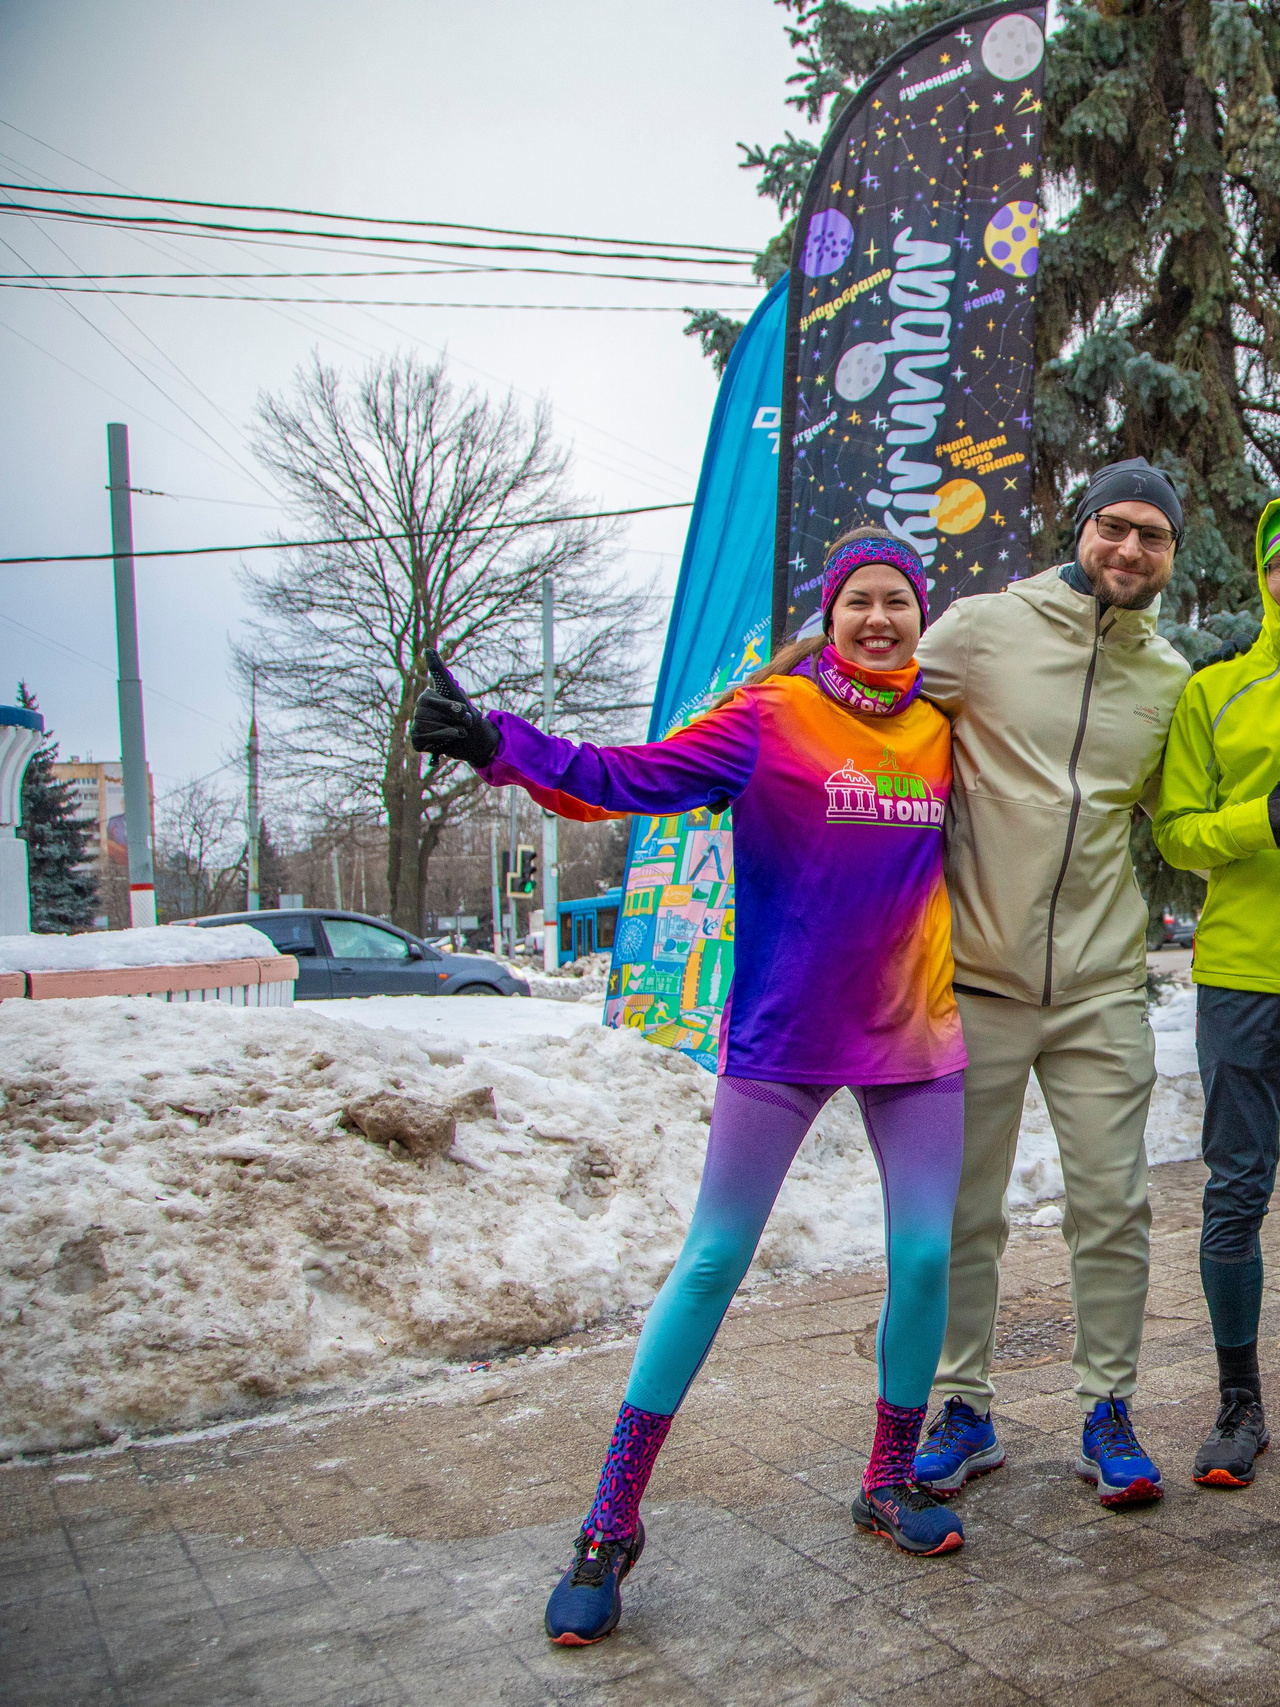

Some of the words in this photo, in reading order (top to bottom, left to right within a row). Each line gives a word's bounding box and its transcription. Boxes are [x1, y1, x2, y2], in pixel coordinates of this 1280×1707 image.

[800, 268, 892, 332] #надобрать
[935, 435, 973, 457] #чат
[950, 434, 1007, 467] должен
[962, 451, 993, 470] это
[977, 451, 1025, 475] знать
[876, 775, 926, 799] RUN
[879, 798, 945, 826] TOND
